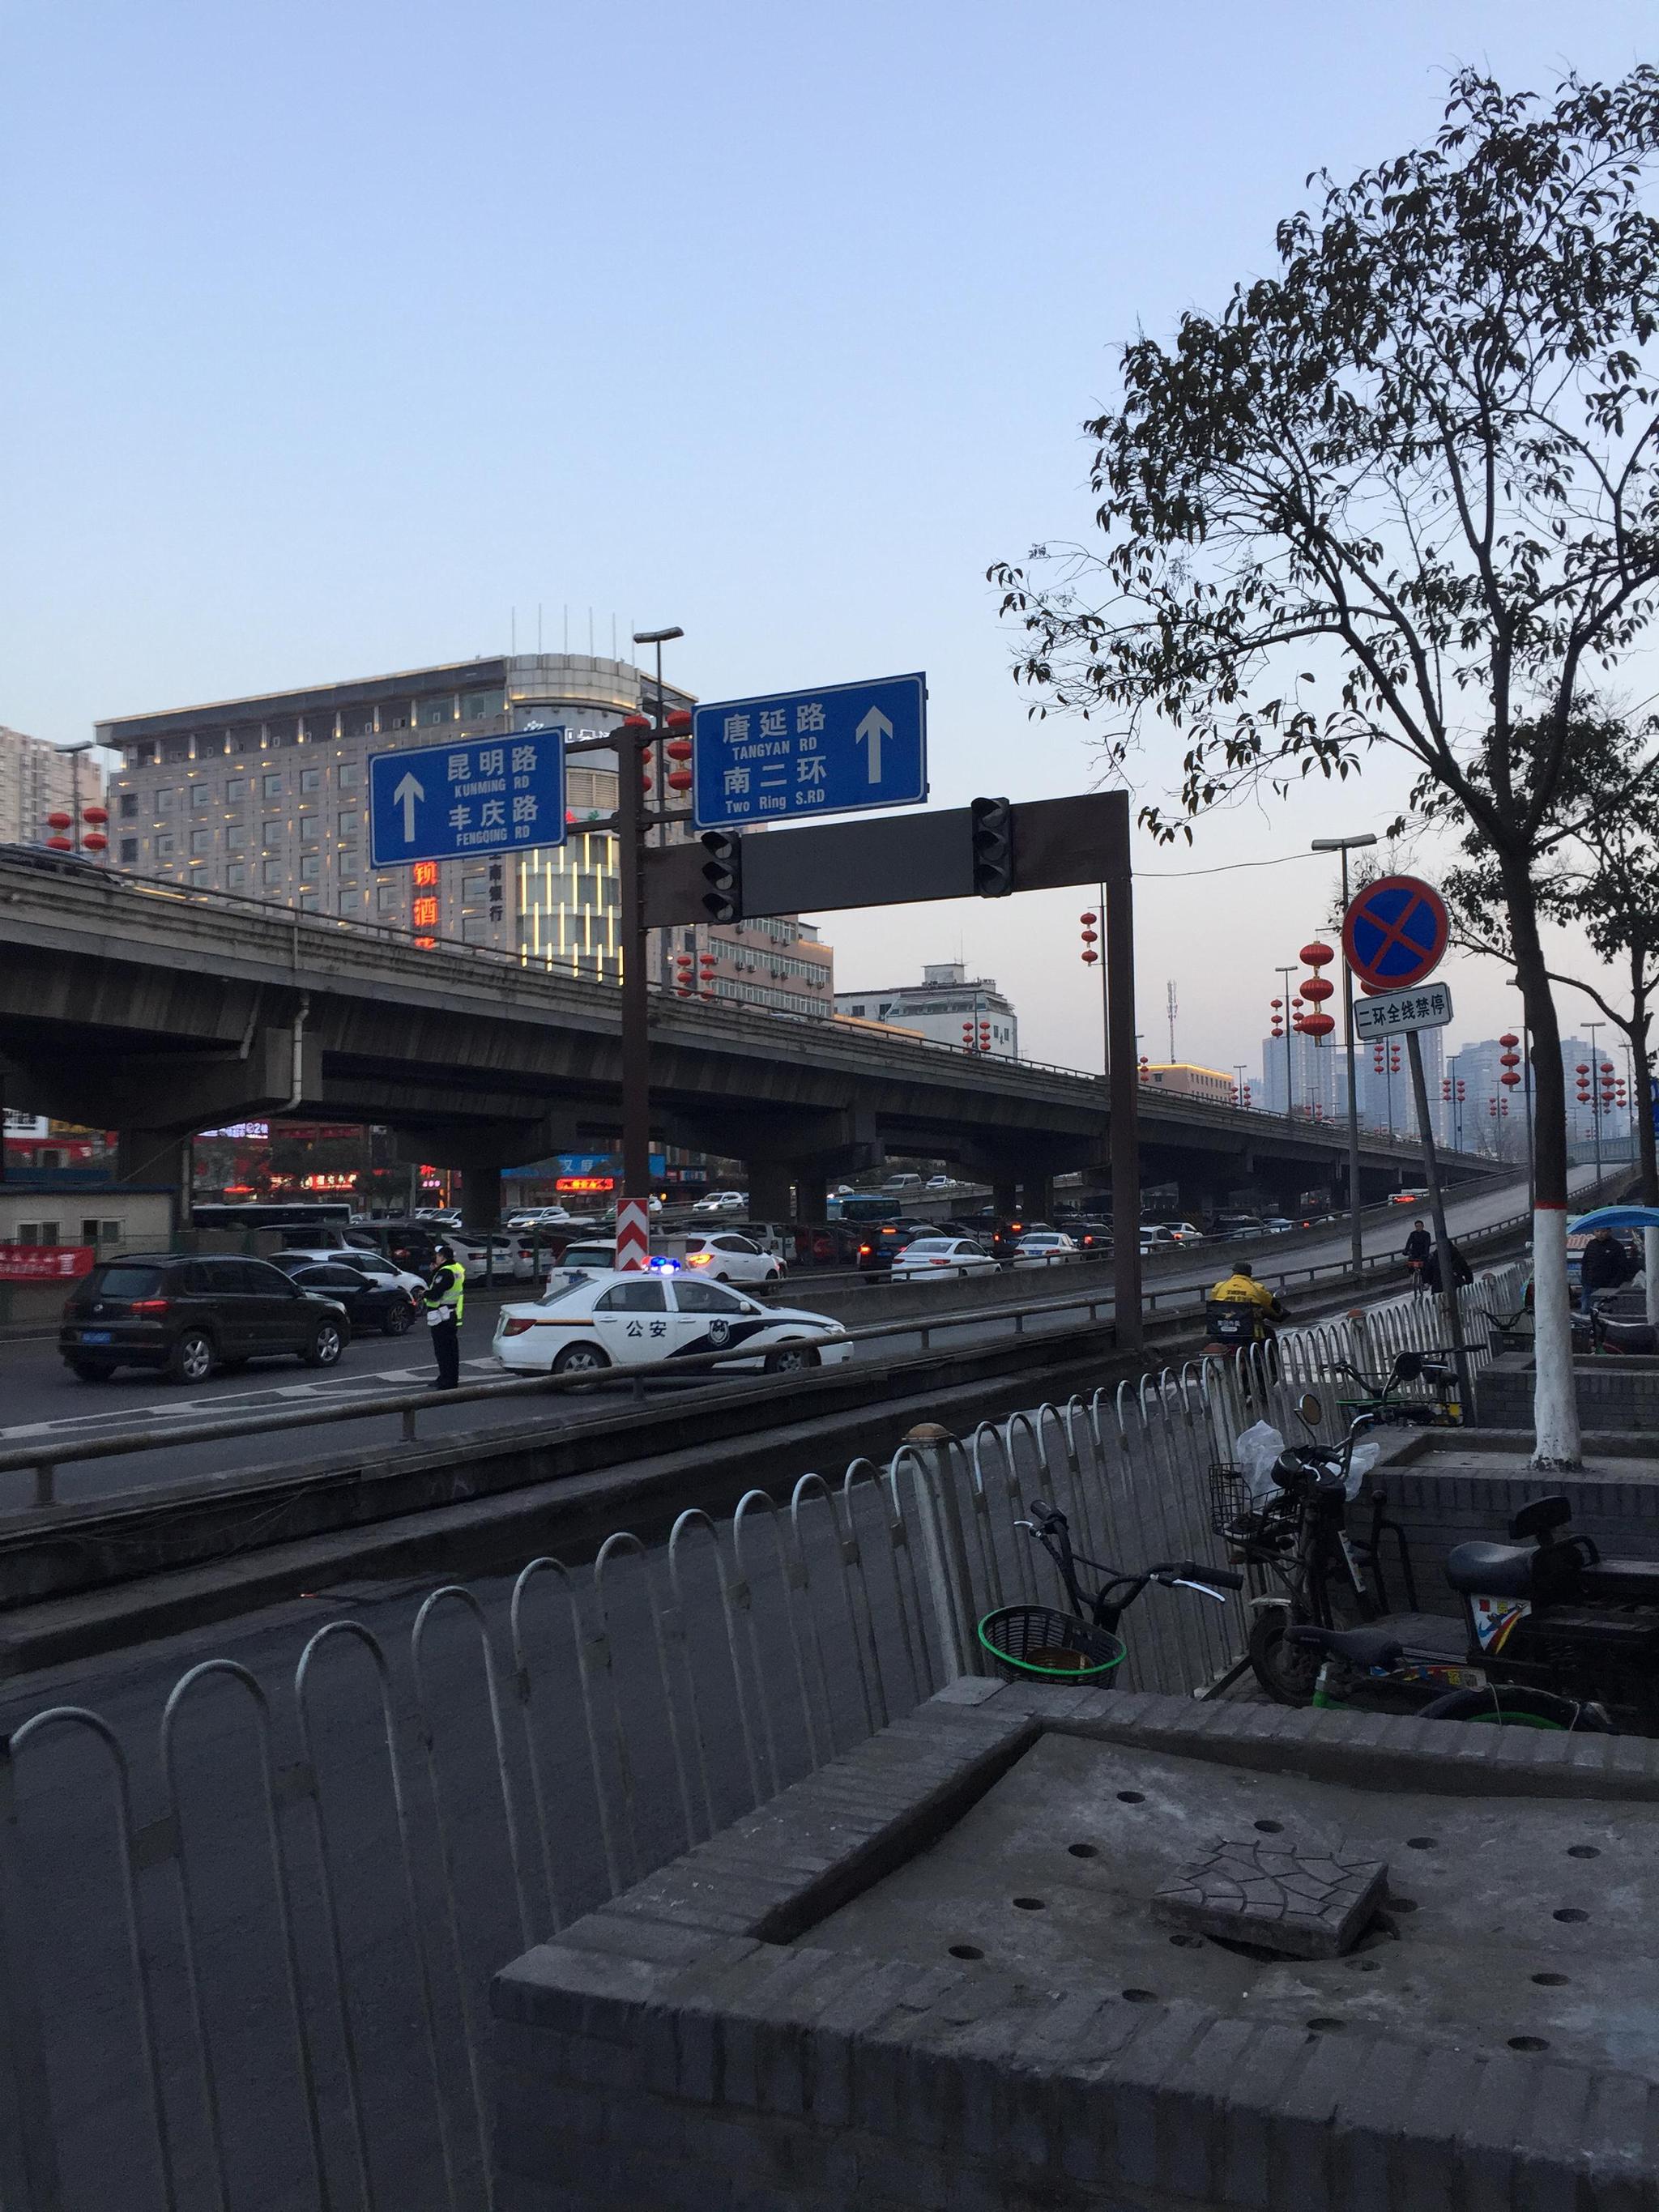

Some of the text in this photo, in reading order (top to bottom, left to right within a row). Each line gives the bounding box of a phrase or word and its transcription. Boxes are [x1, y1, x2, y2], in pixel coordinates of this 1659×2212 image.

[723, 702, 826, 744] 唐延路
[732, 736, 817, 761] TANGYAN RD
[447, 745, 538, 782] 昆明路
[723, 756, 827, 795] 南二环
[454, 775, 529, 799] KUNMING RD
[726, 789, 825, 814] Two Ring S.RD
[449, 795, 539, 831] 丰庆路
[515, 825, 530, 839] RD
[1358, 993, 1445, 1027] 二环全线禁停
[625, 1319, 667, 1338] 公安
